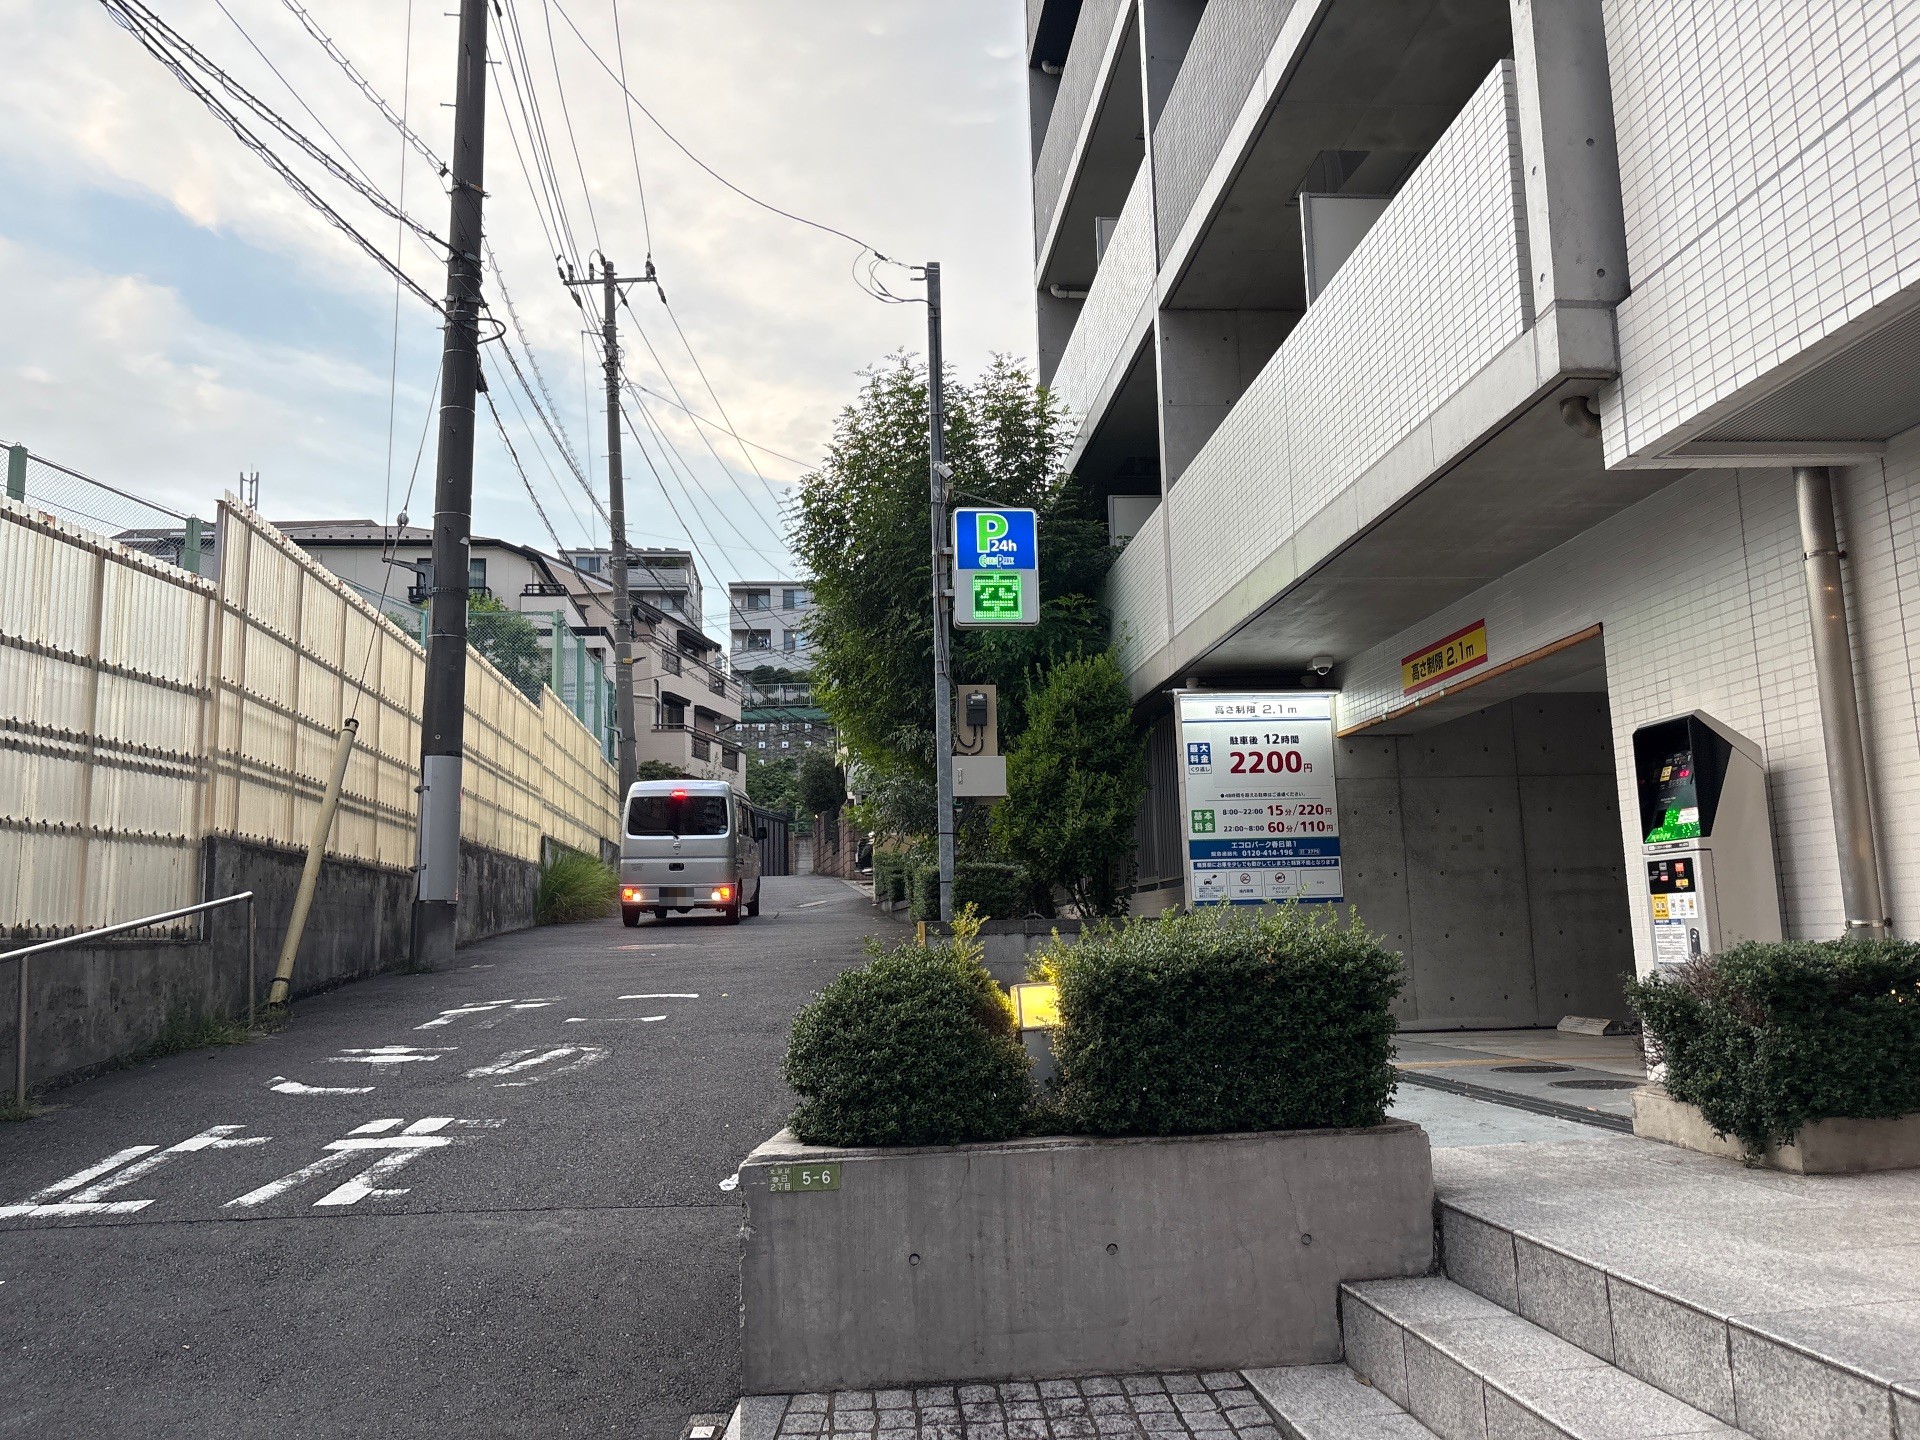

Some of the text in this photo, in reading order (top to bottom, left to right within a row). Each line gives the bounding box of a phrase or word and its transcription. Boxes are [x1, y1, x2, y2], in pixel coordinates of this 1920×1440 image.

[976, 513, 1009, 553] P
[990, 540, 1017, 552] 24h
[973, 572, 1020, 619] 空
[1411, 641, 1474, 682] 高さ制限 2.1m
[1215, 705, 1256, 715] 高さ制限
[1229, 734, 1300, 745] 駐車後 12時間
[1189, 744, 1209, 753] 最大
[1189, 754, 1210, 764] 料金
[1229, 750, 1313, 774] 2200円
[1193, 811, 1213, 820] 基本
[1194, 822, 1214, 831] 料金
[1241, 849, 1294, 857] 0120-414-196
[802, 1170, 831, 1185] 5-6
[770, 1182, 791, 1192] 2丁目
